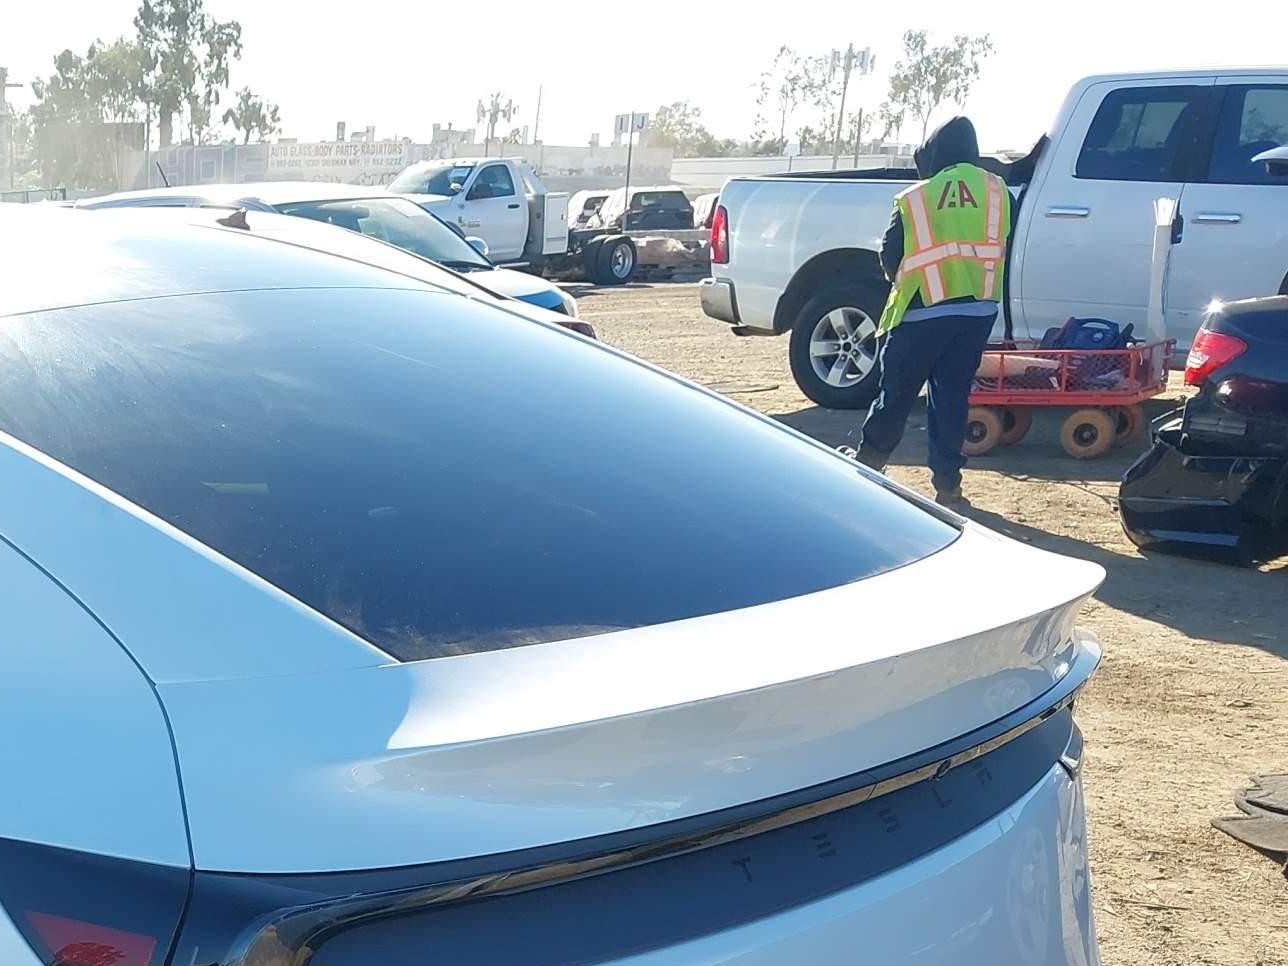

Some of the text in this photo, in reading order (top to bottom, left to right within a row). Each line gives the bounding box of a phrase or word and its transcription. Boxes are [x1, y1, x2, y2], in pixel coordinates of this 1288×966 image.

[637, 115, 645, 129] J
[271, 146, 288, 158] AUTO
[731, 760, 994, 884] TESLA
